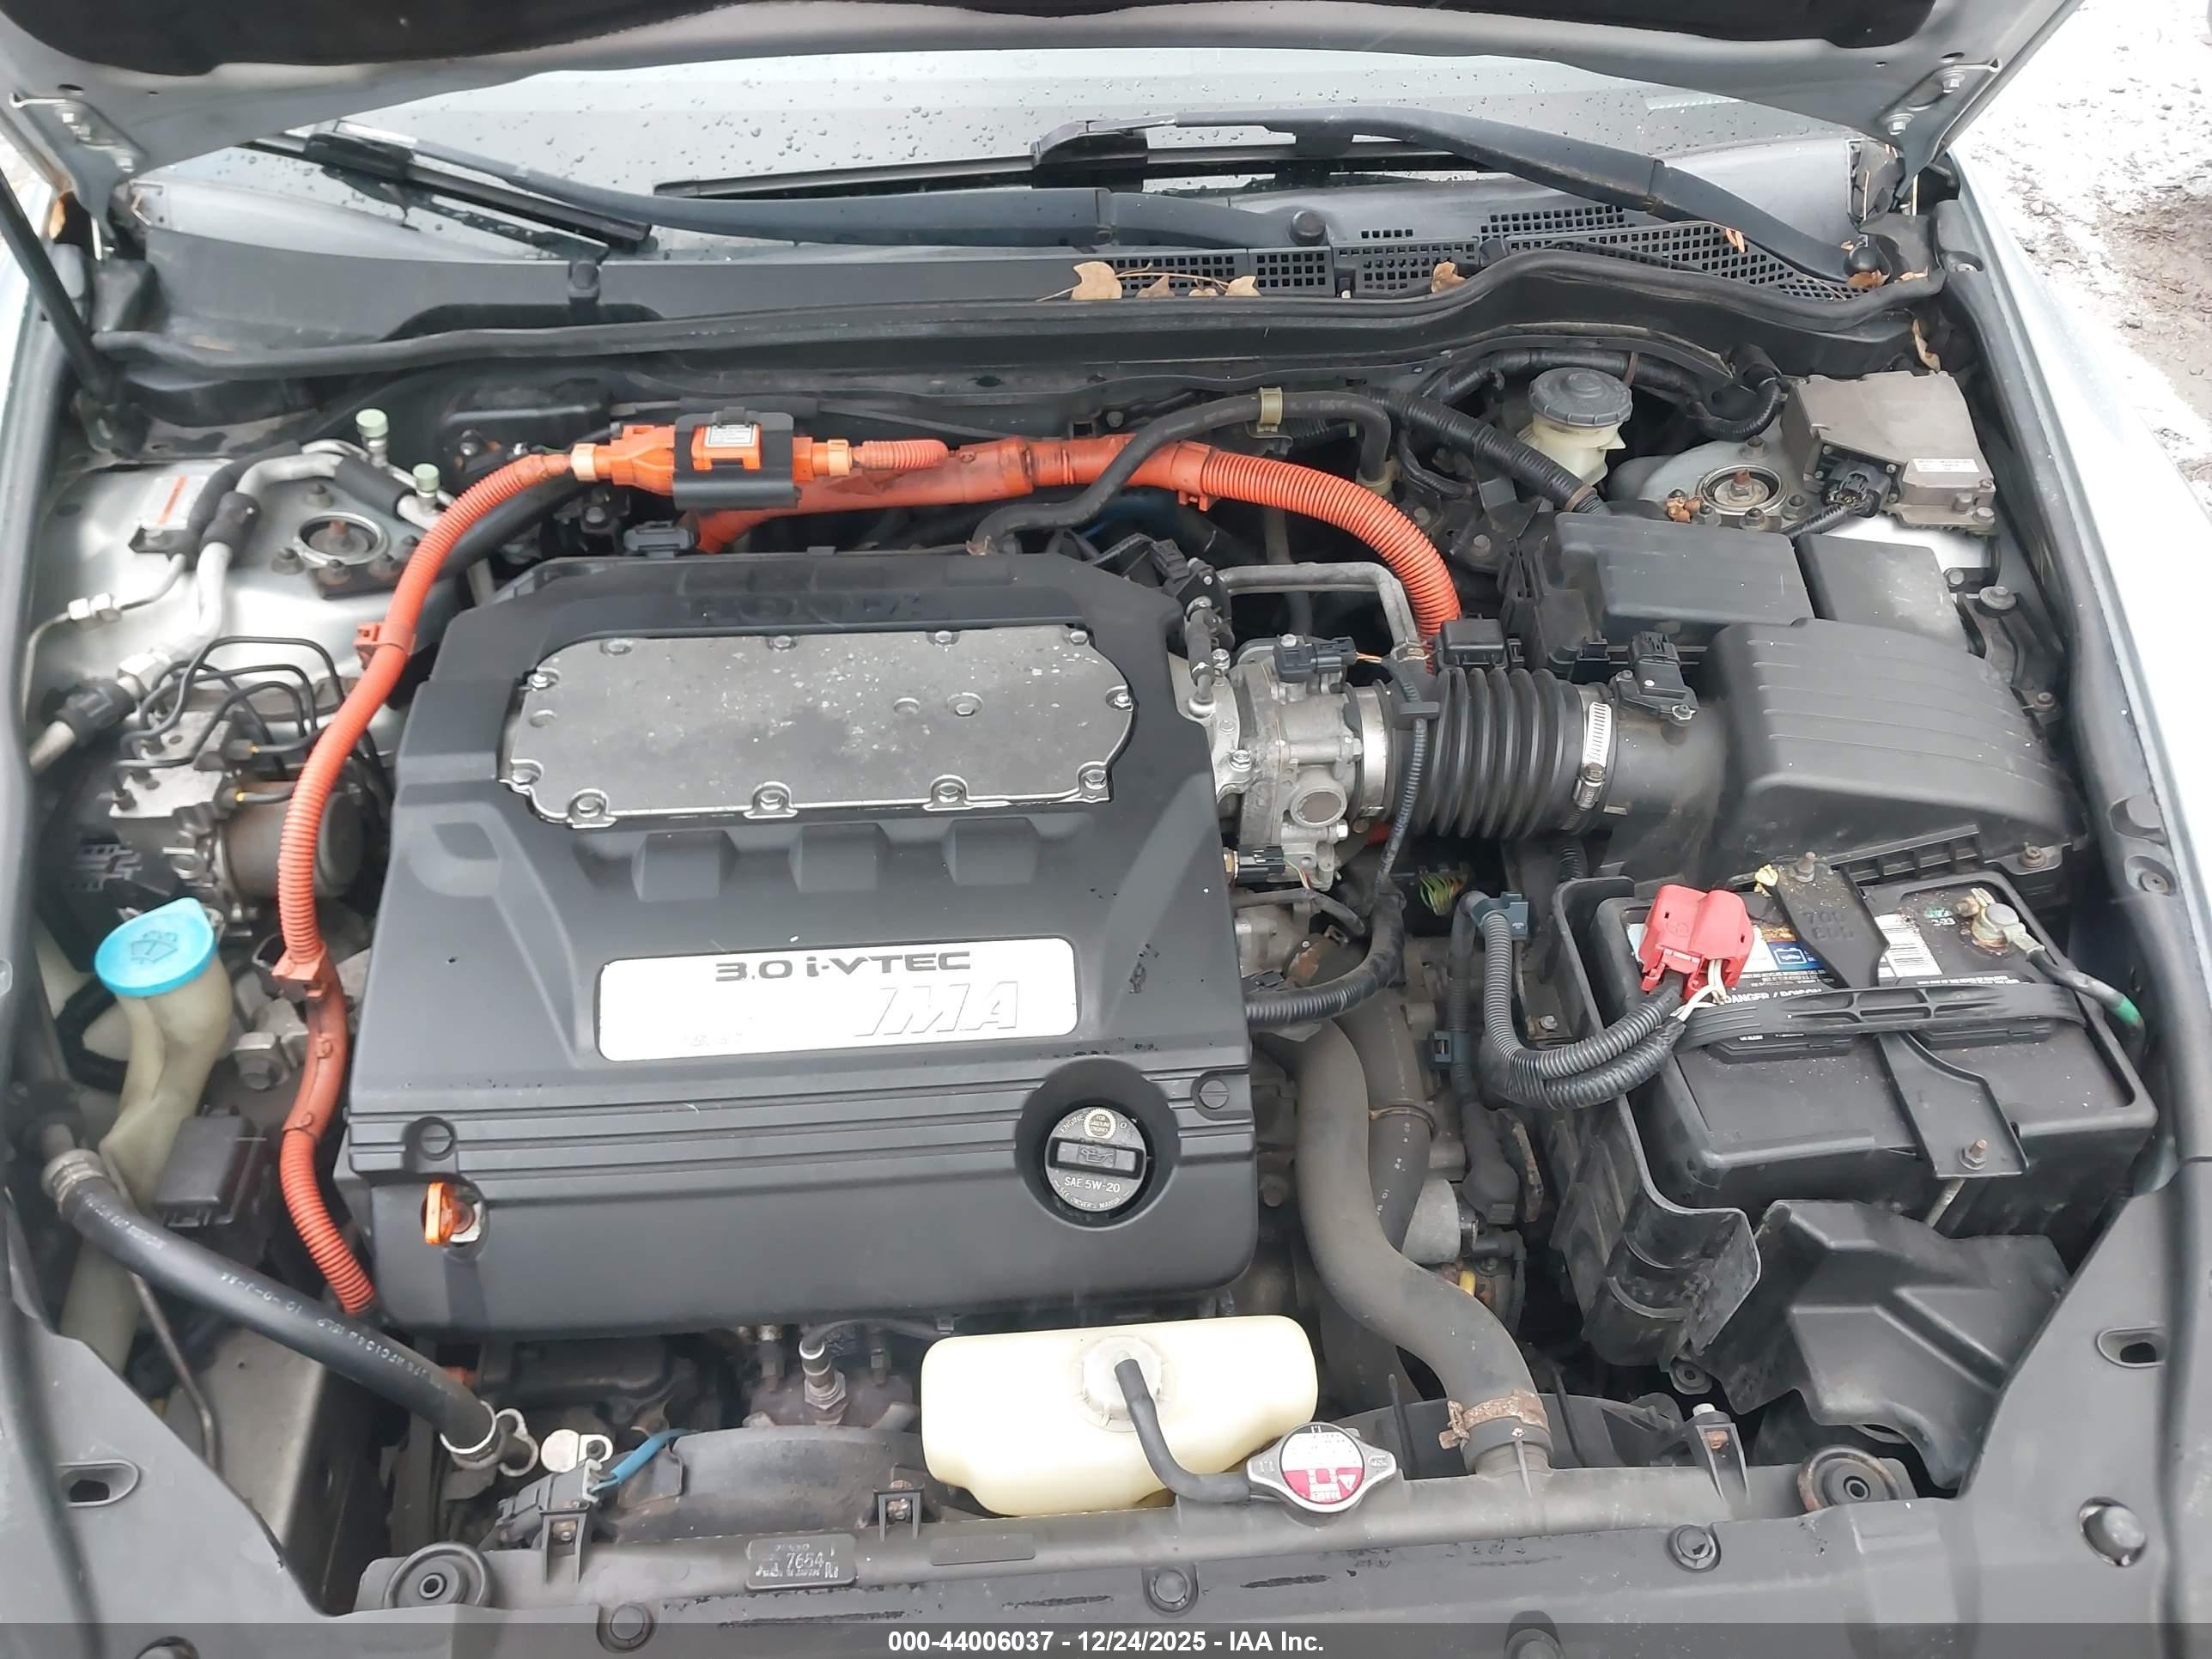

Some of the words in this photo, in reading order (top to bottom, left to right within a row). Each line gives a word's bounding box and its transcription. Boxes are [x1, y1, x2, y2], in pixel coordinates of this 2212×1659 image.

[714, 958, 793, 981] 3.0
[805, 951, 971, 977] i-VTEC
[854, 981, 1019, 1037] IMA
[1059, 1113, 1085, 1133] ENGINE
[1064, 1176, 1083, 1187] SAE
[1085, 1179, 1121, 1194] 5W-20
